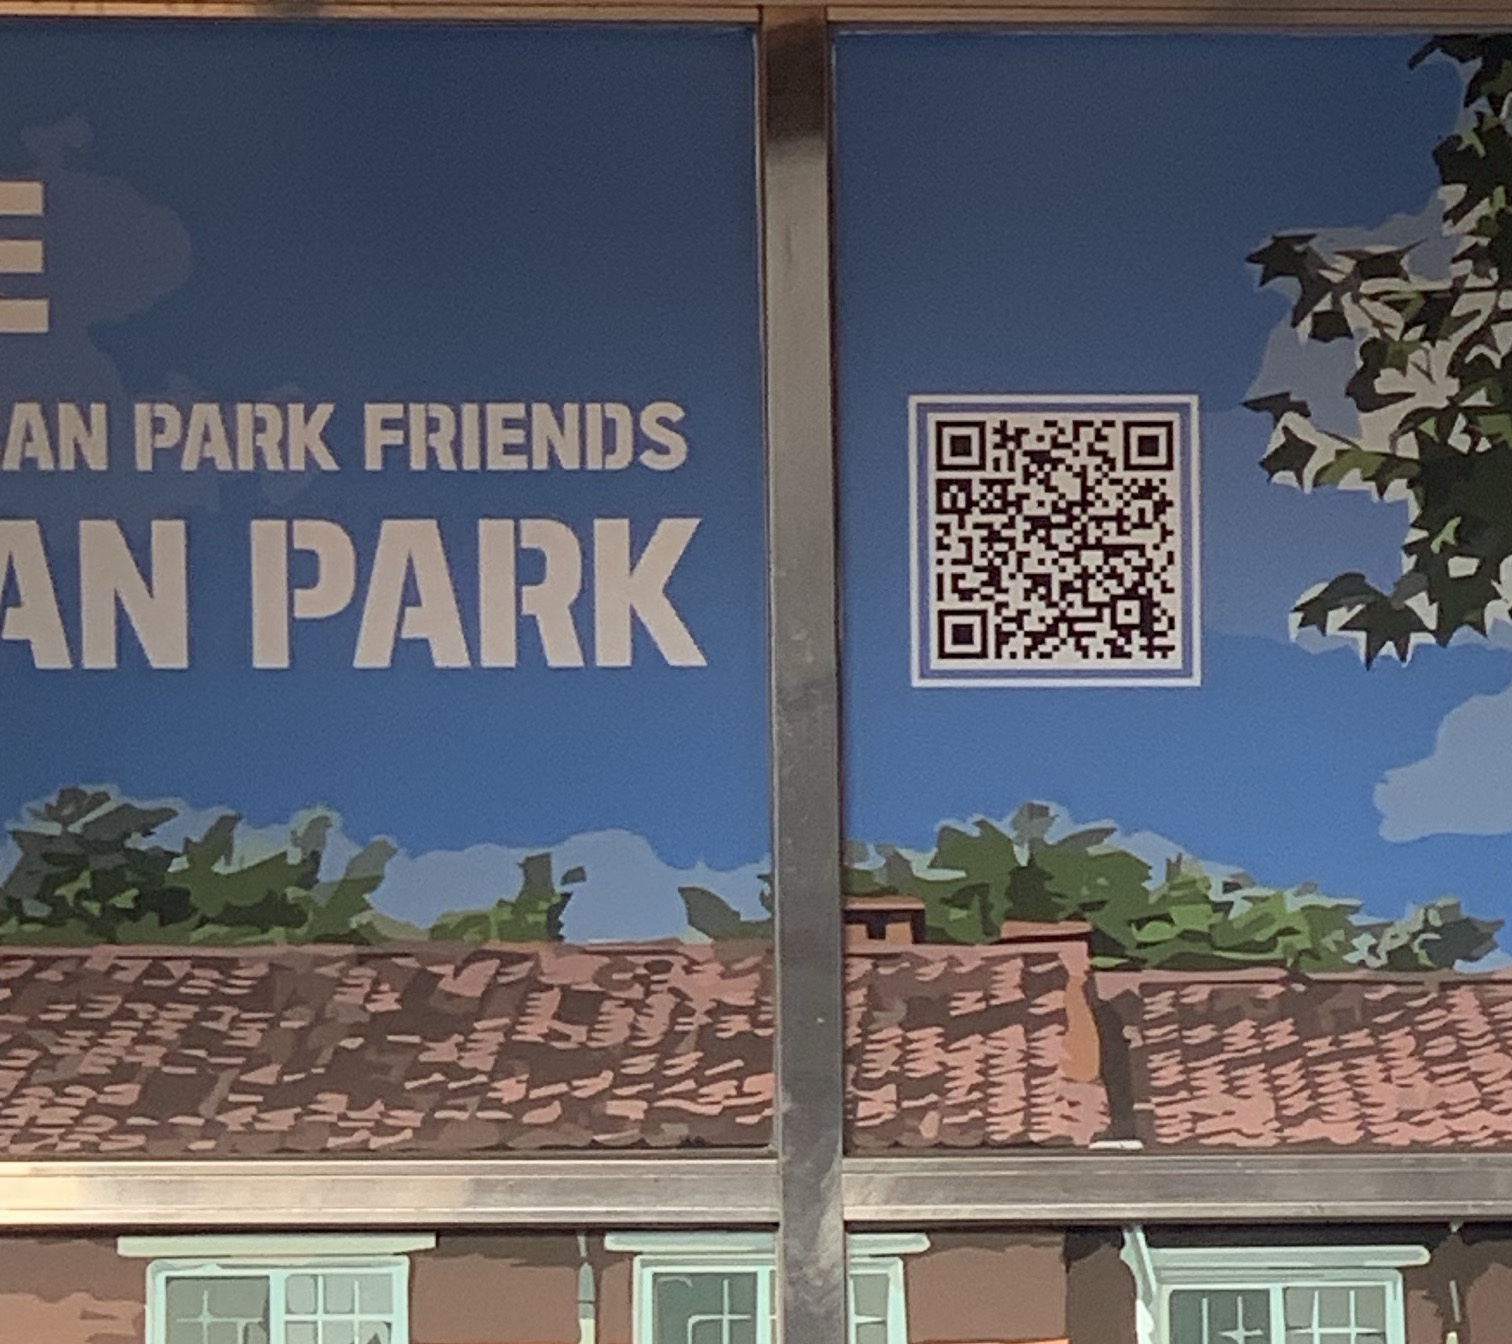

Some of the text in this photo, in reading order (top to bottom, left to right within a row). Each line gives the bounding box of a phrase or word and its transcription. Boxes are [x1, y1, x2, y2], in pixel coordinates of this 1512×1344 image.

[3, 401, 689, 472] AN PARK FRIENDS
[0, 518, 708, 670] AN PARK
